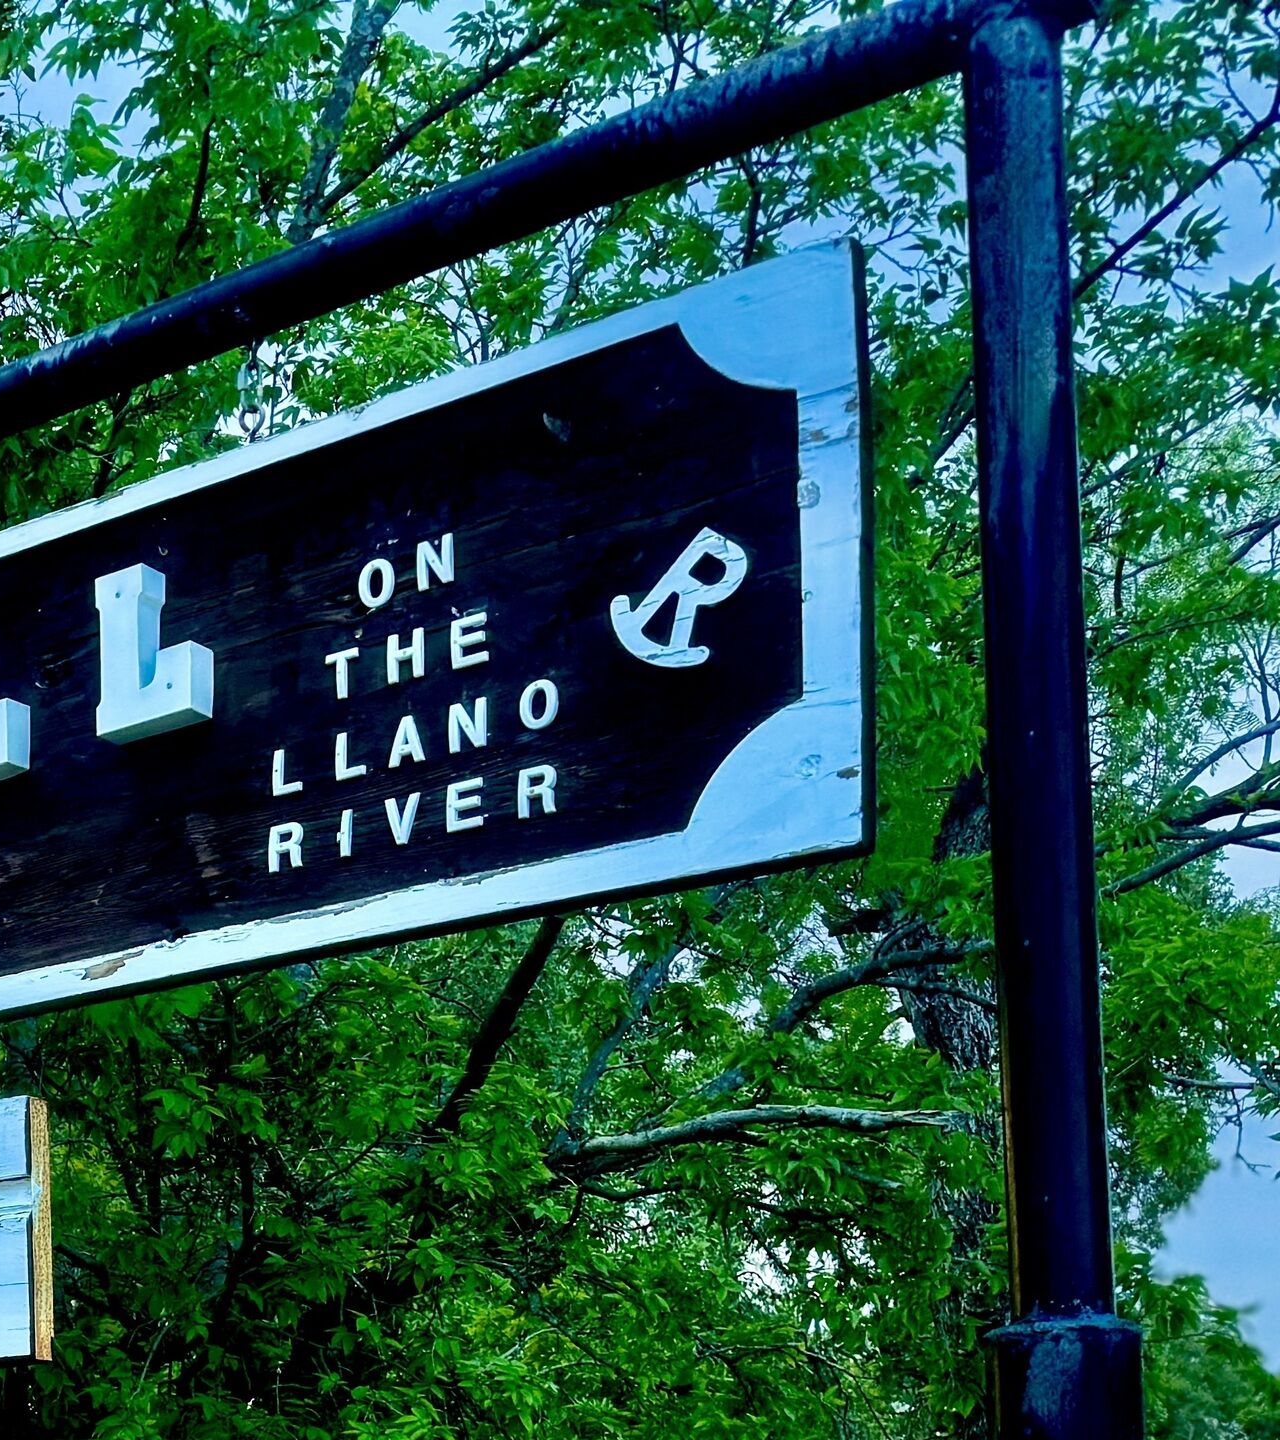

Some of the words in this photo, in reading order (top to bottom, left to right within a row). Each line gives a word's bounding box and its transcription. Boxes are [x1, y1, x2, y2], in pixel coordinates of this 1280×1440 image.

[358, 532, 455, 611] ON
[325, 611, 490, 699] THE
[272, 679, 560, 797] LLANO
[267, 764, 557, 873] RIVER
